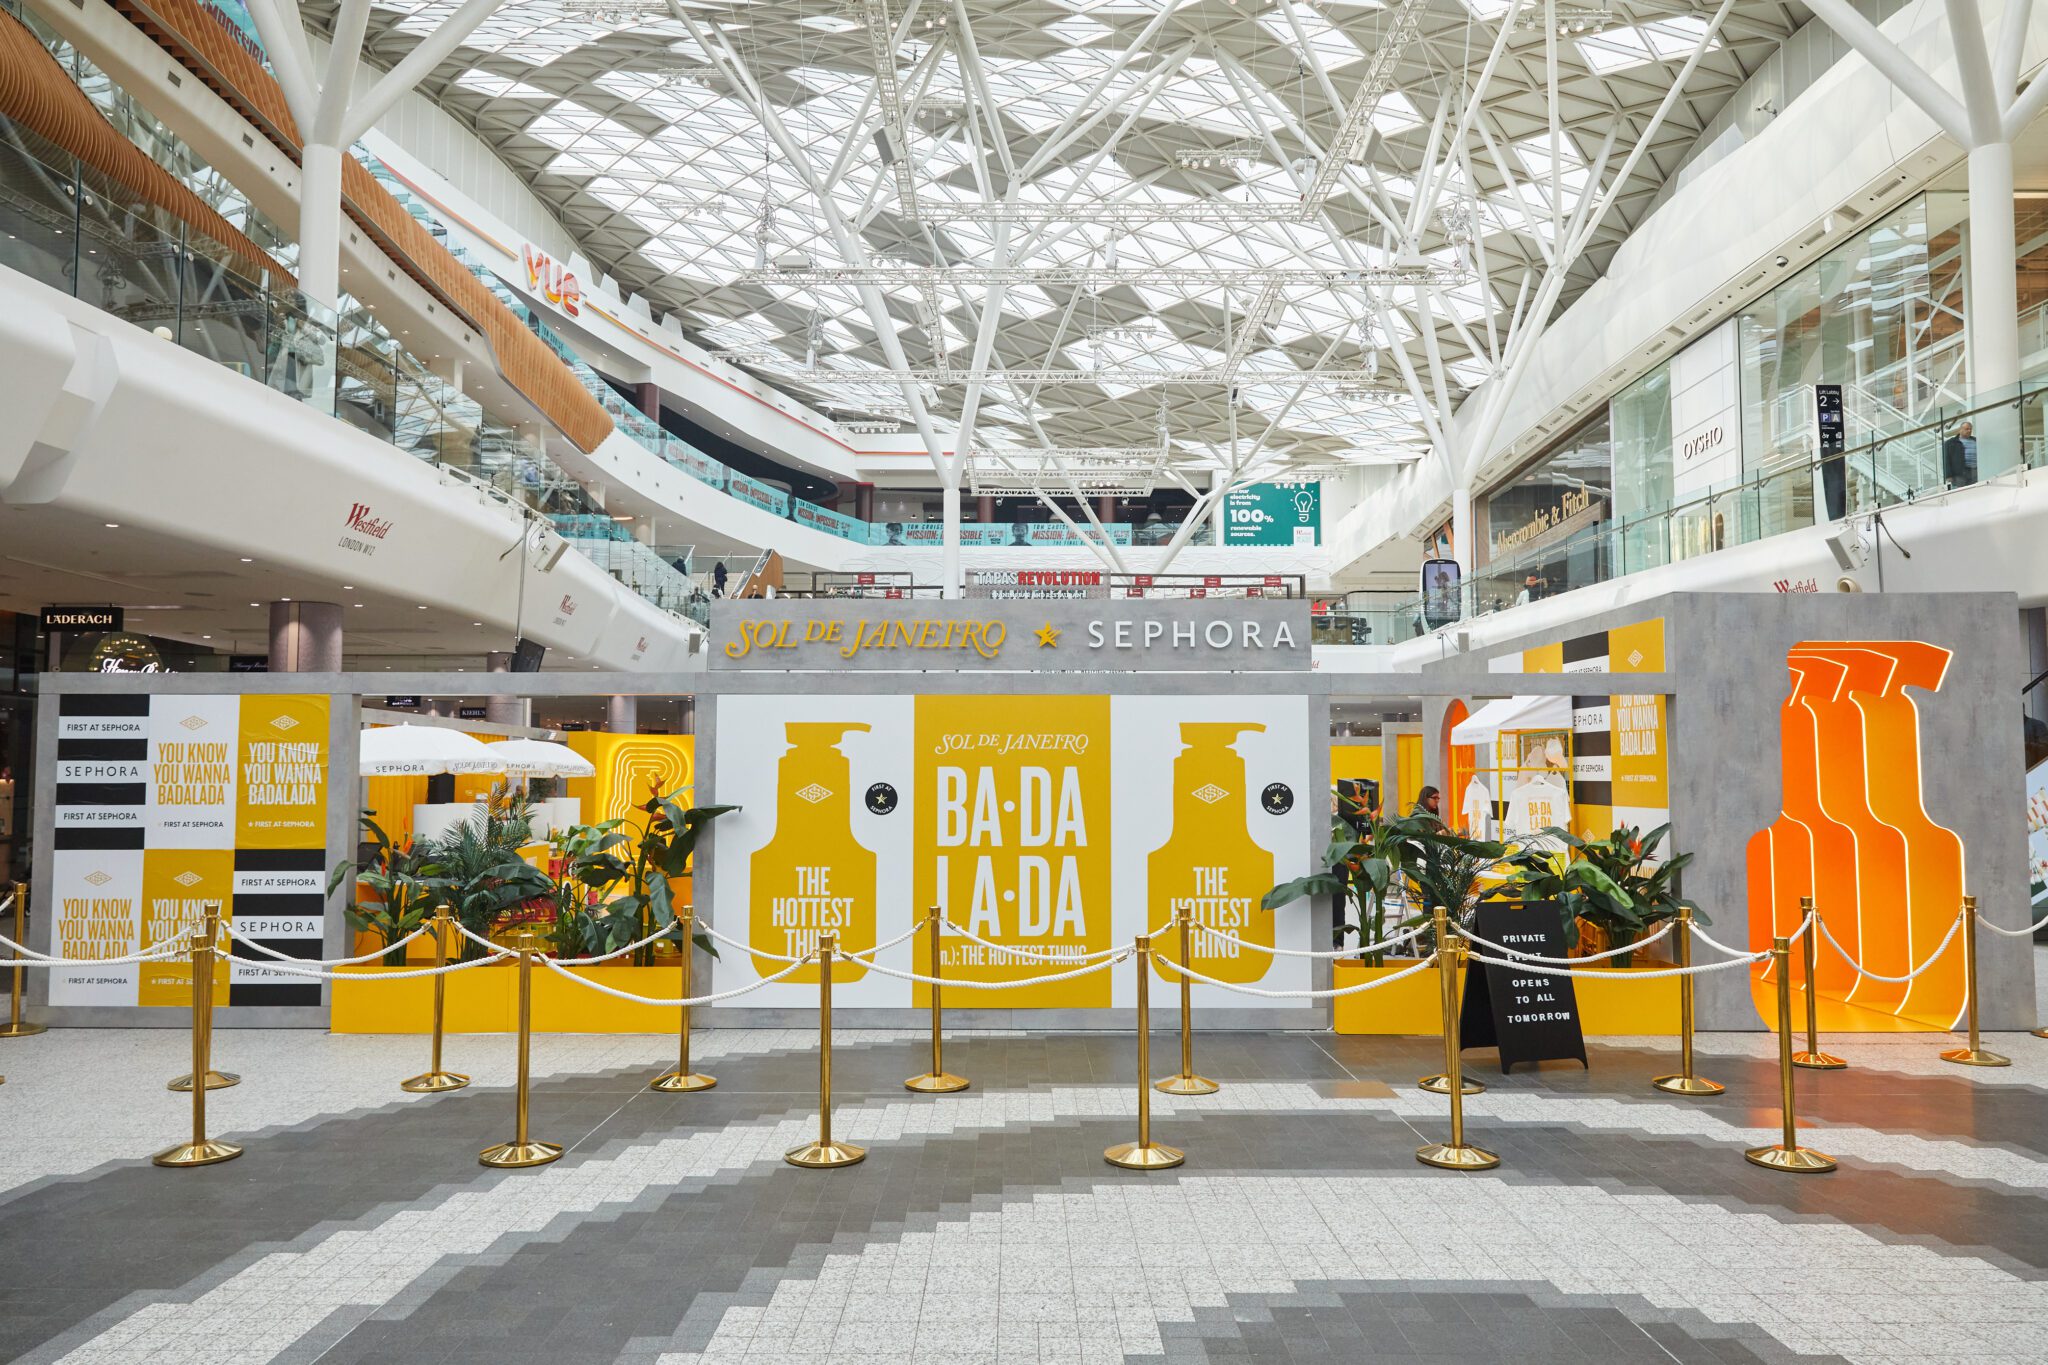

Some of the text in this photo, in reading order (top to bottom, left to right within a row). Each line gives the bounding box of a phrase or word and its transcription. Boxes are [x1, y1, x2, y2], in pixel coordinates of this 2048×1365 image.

[1820, 396, 1827, 406] 2
[1683, 426, 1723, 460] OYSHO
[344, 503, 394, 539] Westfield
[1230, 509, 1274, 523] 100%
[1497, 481, 1589, 555] Abercrombie & Fitch
[725, 620, 1295, 658] SOL DE JANEIRO SEPHORA
[67, 724, 88, 732] FIRST
[101, 723, 140, 731] SEPHORA
[1573, 713, 1603, 727] EPHORA
[1617, 704, 1659, 732] YOU WANNA
[157, 742, 228, 764] YOU KNOW
[248, 742, 320, 764] YOU KNOW
[934, 733, 1089, 754] SOL DE JANEIRO
[1620, 730, 1656, 757] BADALADA
[65, 766, 139, 777] SEPHORA
[154, 763, 230, 784] YOU WANNA
[244, 763, 322, 784] YOU WANNA
[375, 765, 425, 773] SEPHORA
[1585, 764, 1604, 772] SEPHORA
[157, 784, 225, 805] BADALADA
[248, 784, 317, 805] BADALADA
[1267, 784, 1280, 792] FIRST
[63, 812, 137, 821] FIRST AT SEPHORA
[870, 806, 893, 814] SEPHORA
[1266, 806, 1289, 814] SEPHORA
[241, 878, 316, 887] FIRST AT SEPHORA
[796, 866, 830, 895] THE
[1193, 866, 1228, 896] THE
[63, 899, 132, 919] YOU KNOW
[152, 899, 179, 920] YOU
[772, 897, 854, 926] HOTTEST
[1170, 897, 1252, 927] HOTTEST
[58, 919, 135, 940] YOU WANNA
[147, 920, 174, 941] YOU
[240, 922, 315, 932] SEPHORA
[1502, 934, 1546, 943] PRIVATE
[62, 940, 129, 960] BADALADA
[961, 945, 985, 965] THE
[988, 945, 1044, 966] HOTTEST
[1047, 945, 1087, 966] THING
[238, 968, 260, 976] FIRST
[1512, 979, 1550, 987] OPENS
[1515, 993, 1555, 1004] TO ALL
[1507, 1012, 1570, 1023] TOMORROW
